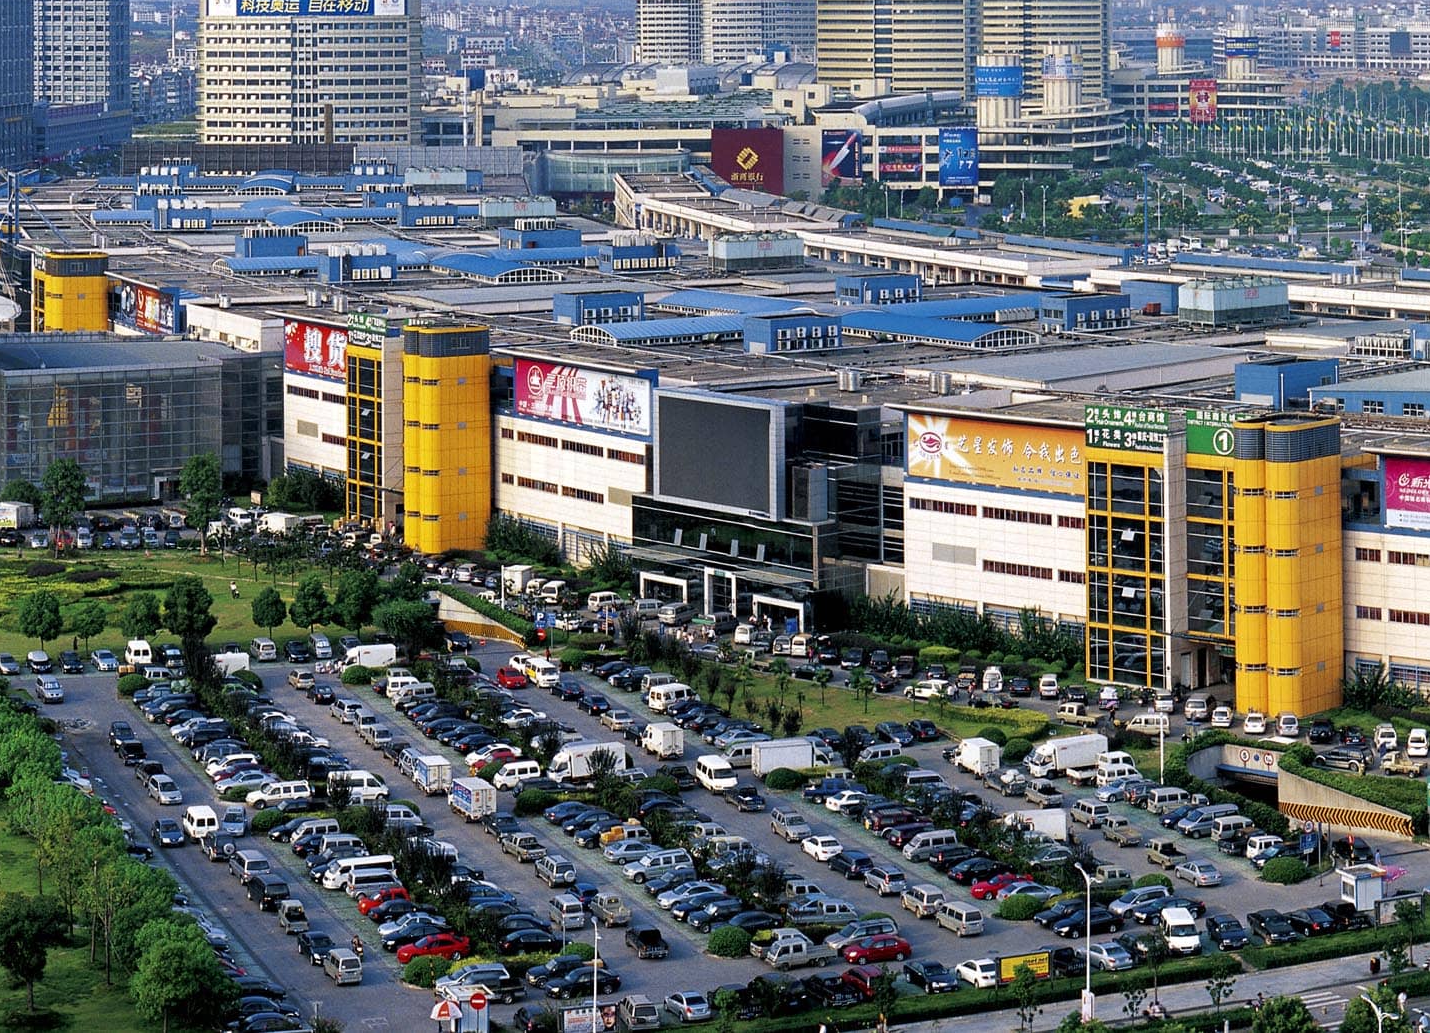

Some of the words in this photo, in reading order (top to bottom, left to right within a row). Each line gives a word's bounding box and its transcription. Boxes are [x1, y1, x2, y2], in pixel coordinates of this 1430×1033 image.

[1138, 411, 1165, 423] 台商馆
[1021, 441, 1083, 465] 令我出色
